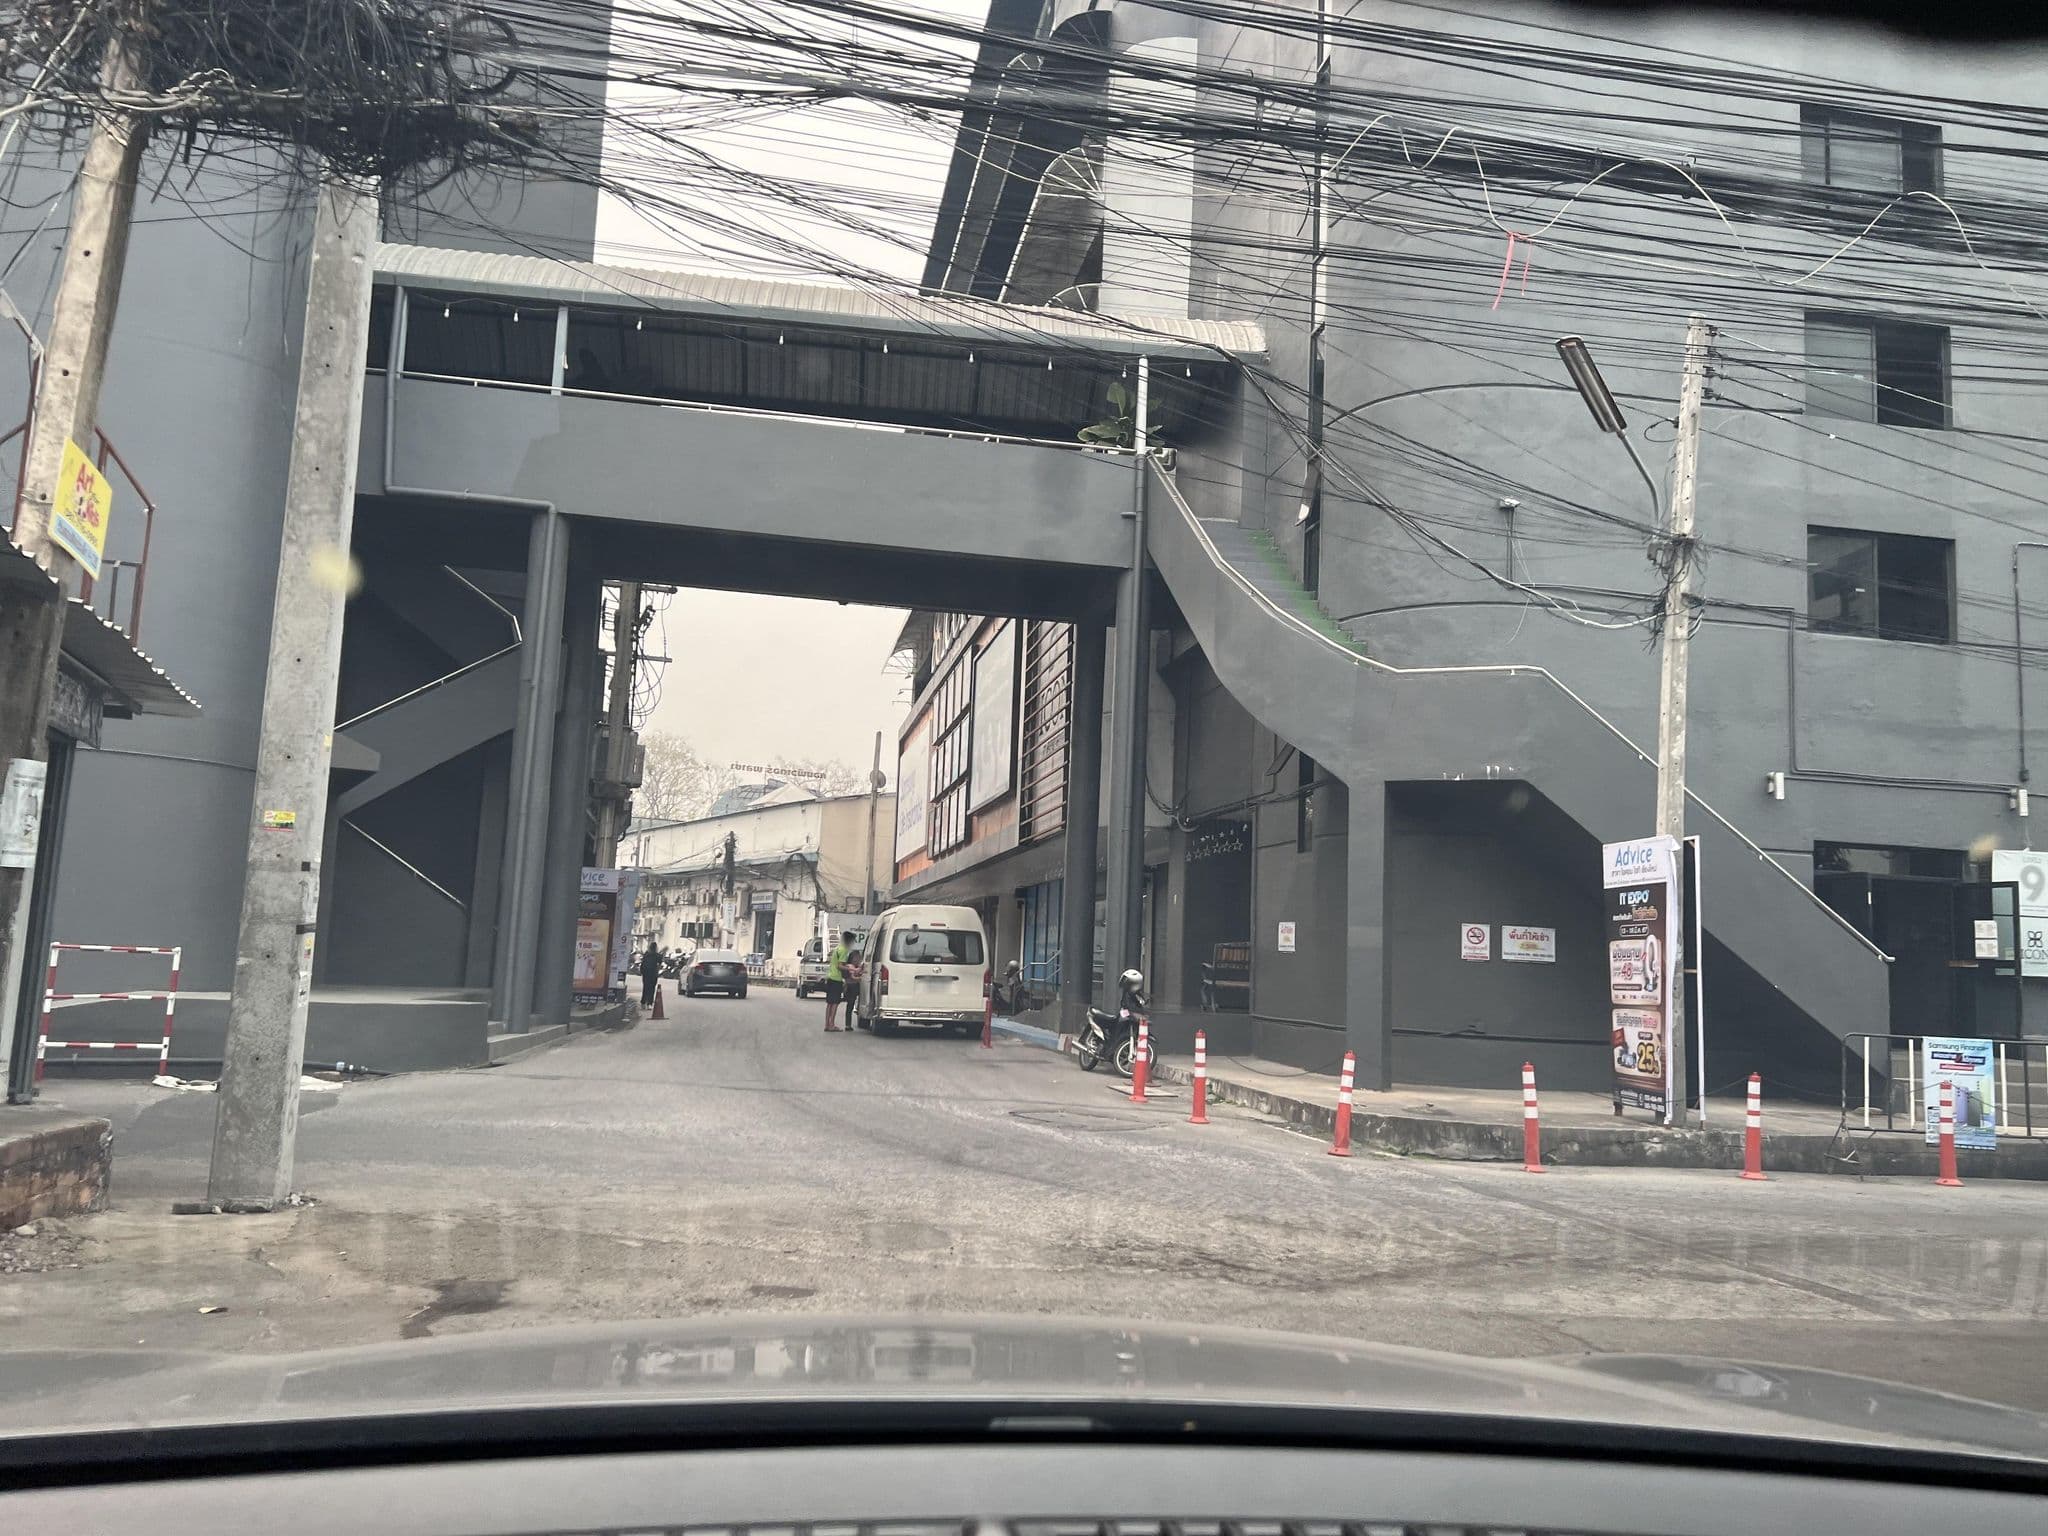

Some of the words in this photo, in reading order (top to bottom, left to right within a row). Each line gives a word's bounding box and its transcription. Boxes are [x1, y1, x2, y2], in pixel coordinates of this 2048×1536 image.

[1615, 845, 1653, 867] Advice
[582, 872, 606, 882] vice
[2020, 865, 2046, 903] 9
[1928, 1042, 1960, 1051] Samsung
